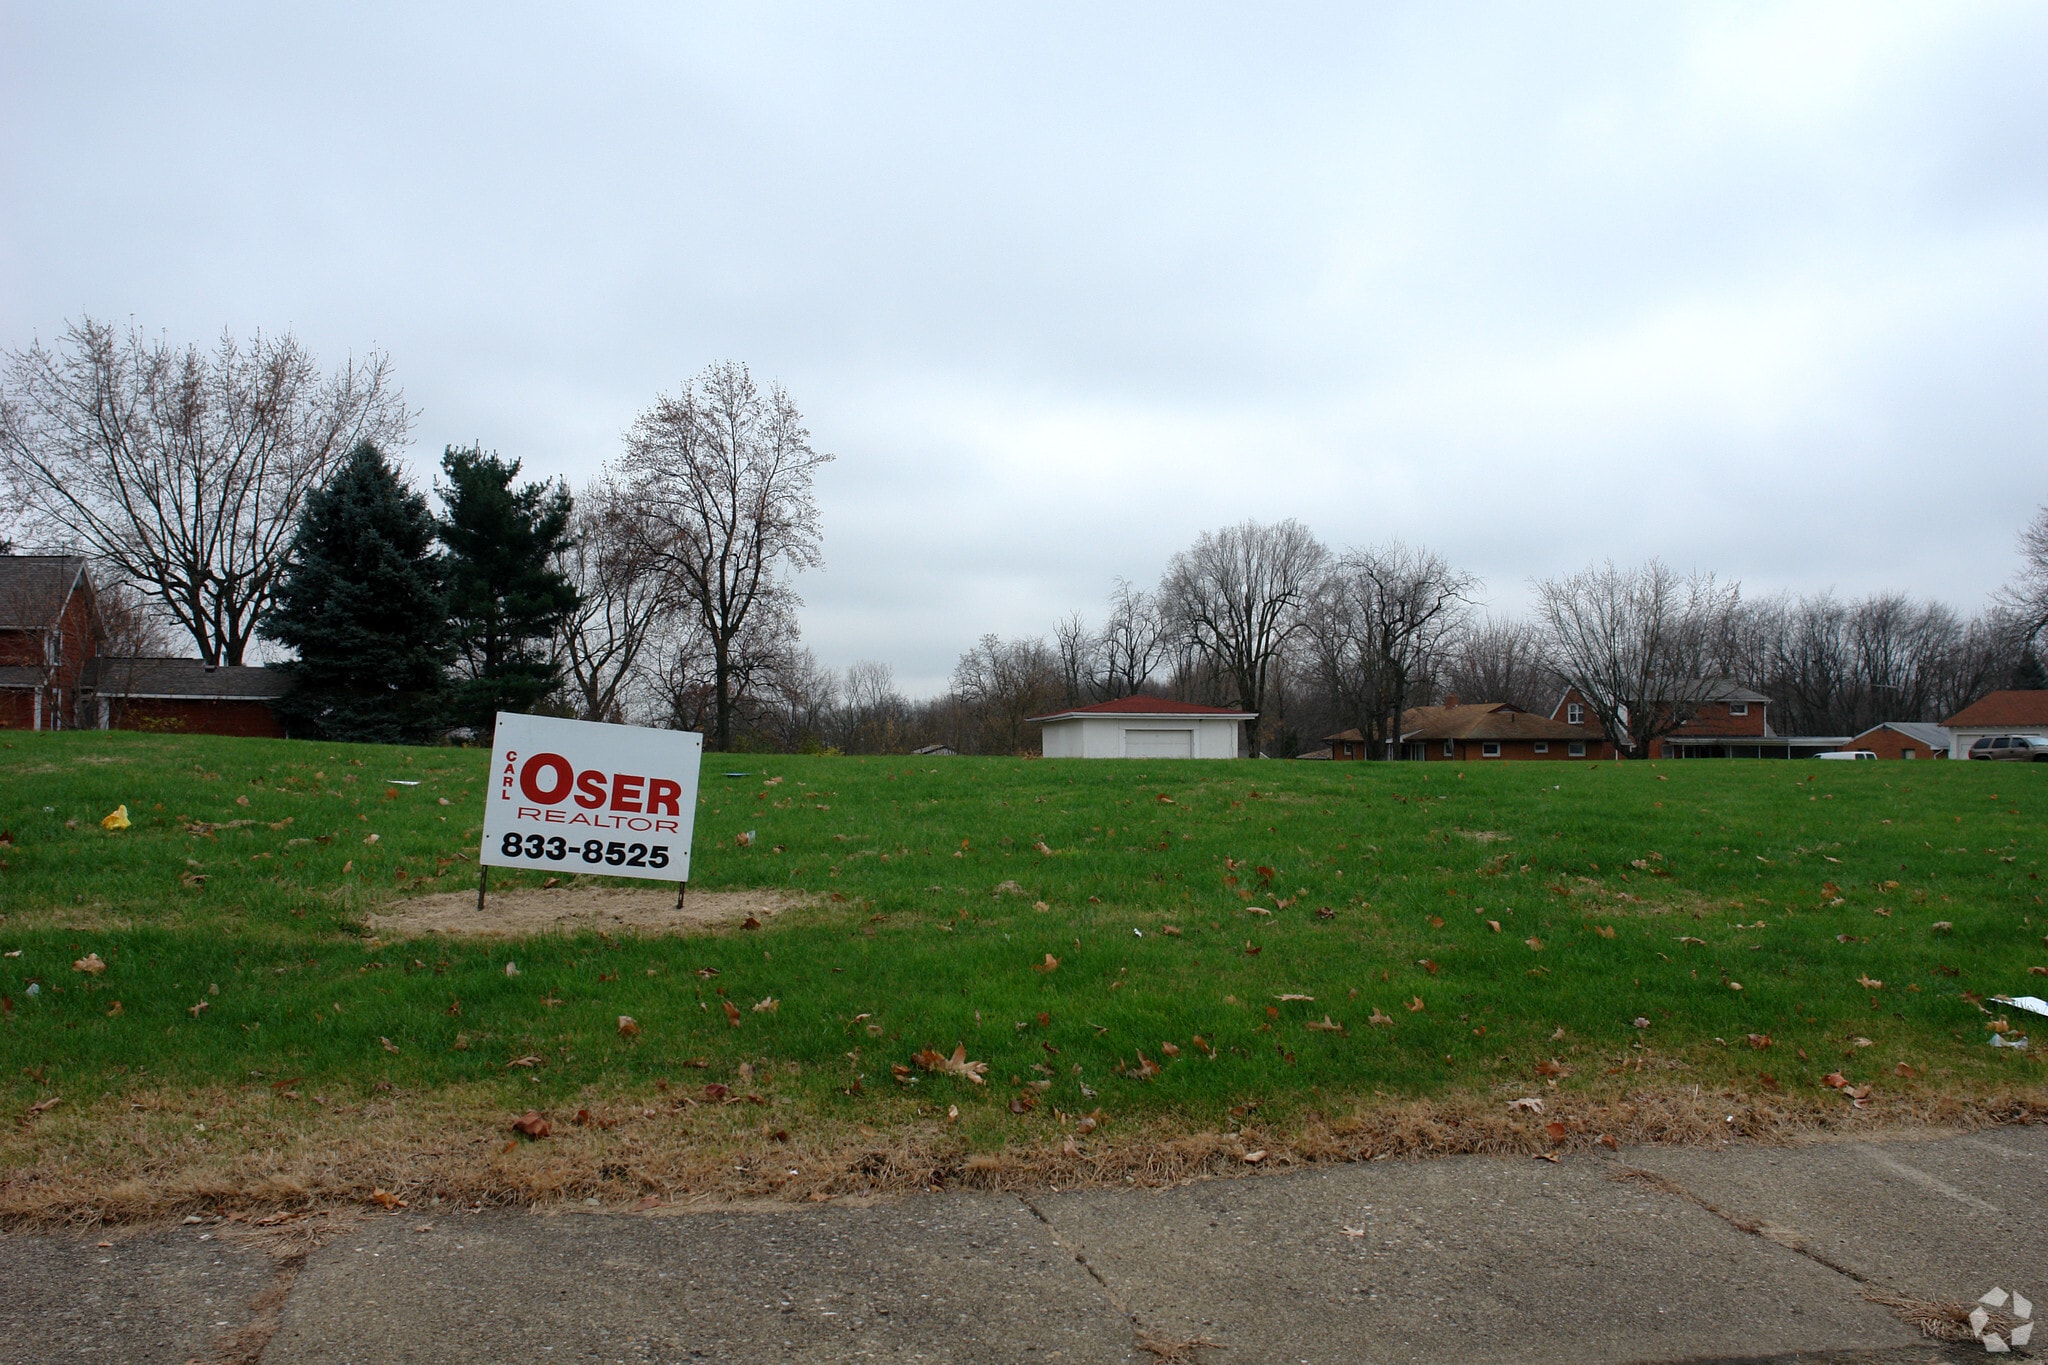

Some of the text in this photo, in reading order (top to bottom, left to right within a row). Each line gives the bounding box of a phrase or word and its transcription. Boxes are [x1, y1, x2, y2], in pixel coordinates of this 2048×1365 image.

[501, 750, 518, 800] CARL
[519, 752, 682, 817] OSER
[517, 807, 679, 834] REALTOR
[501, 832, 670, 869] 833-8525
